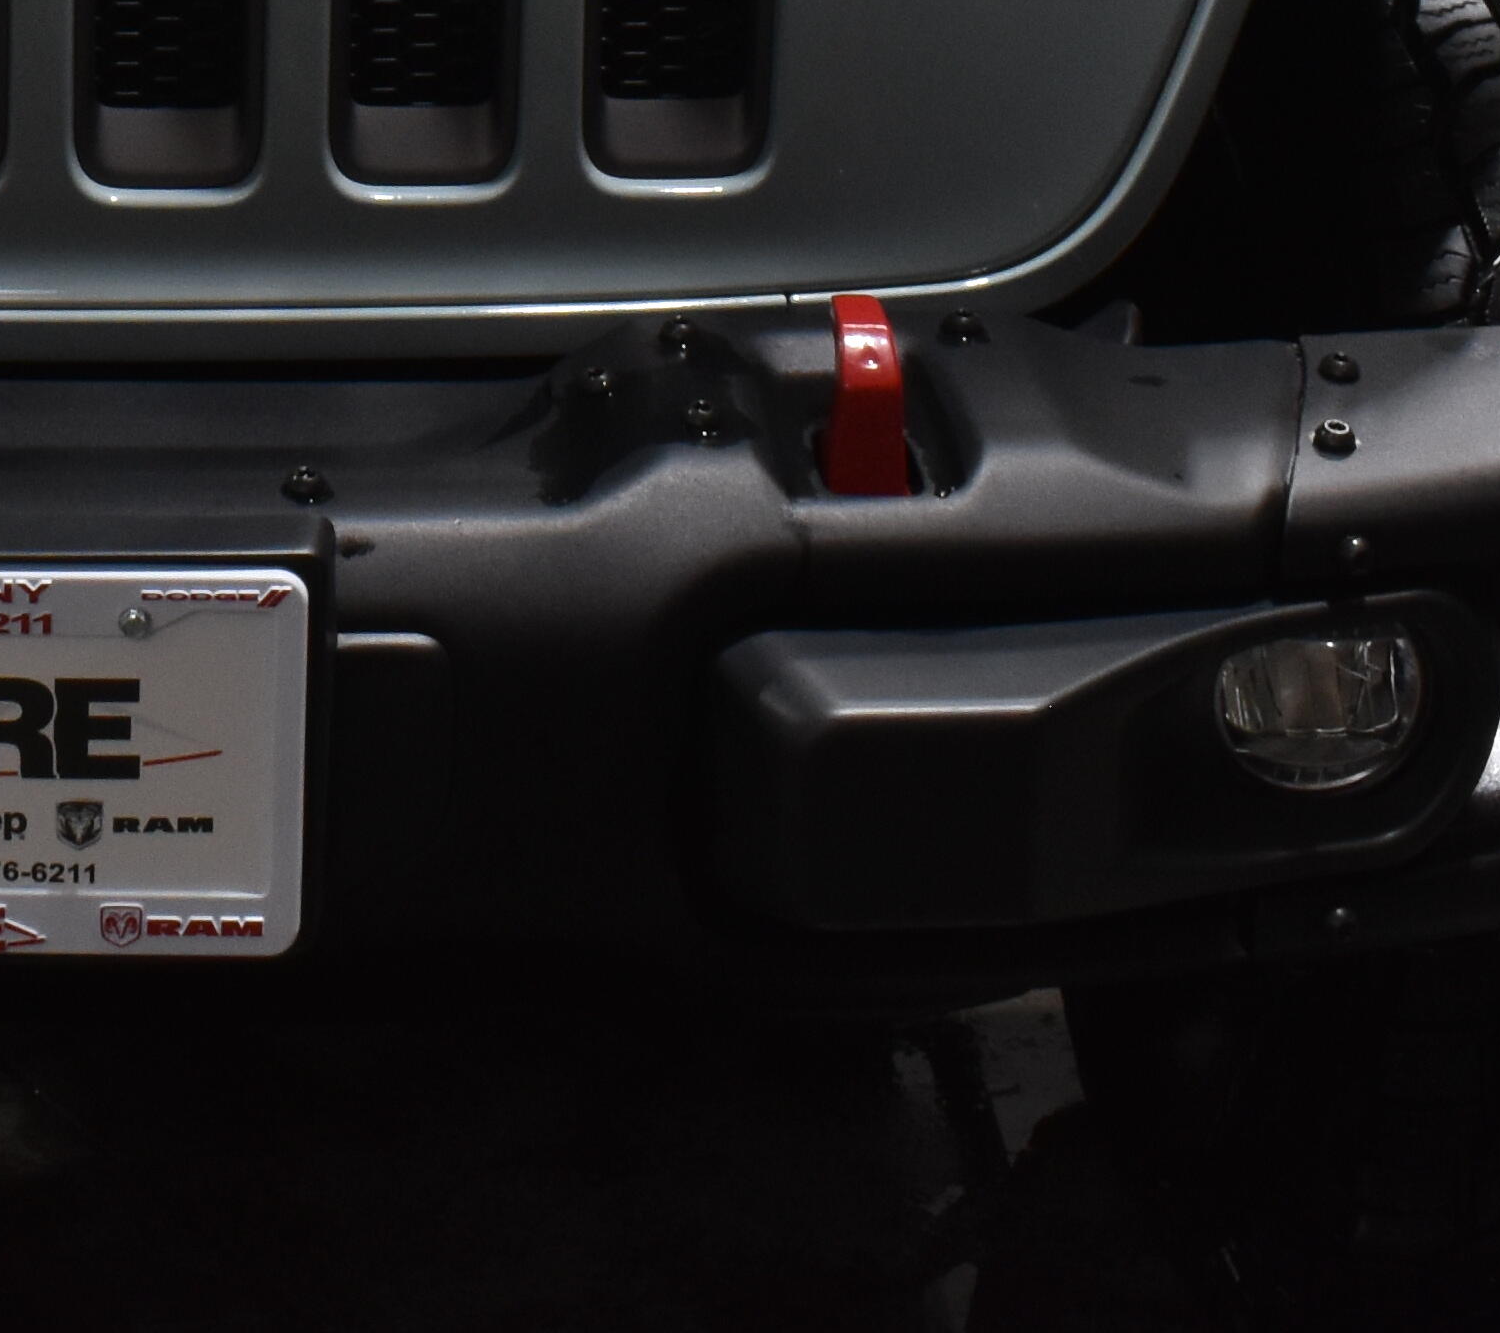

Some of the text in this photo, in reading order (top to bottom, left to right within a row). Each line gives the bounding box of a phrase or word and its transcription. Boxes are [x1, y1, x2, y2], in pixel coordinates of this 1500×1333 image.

[140, 588, 259, 601] DODGE
[113, 815, 214, 834] RAM
[147, 915, 264, 939] RAM
